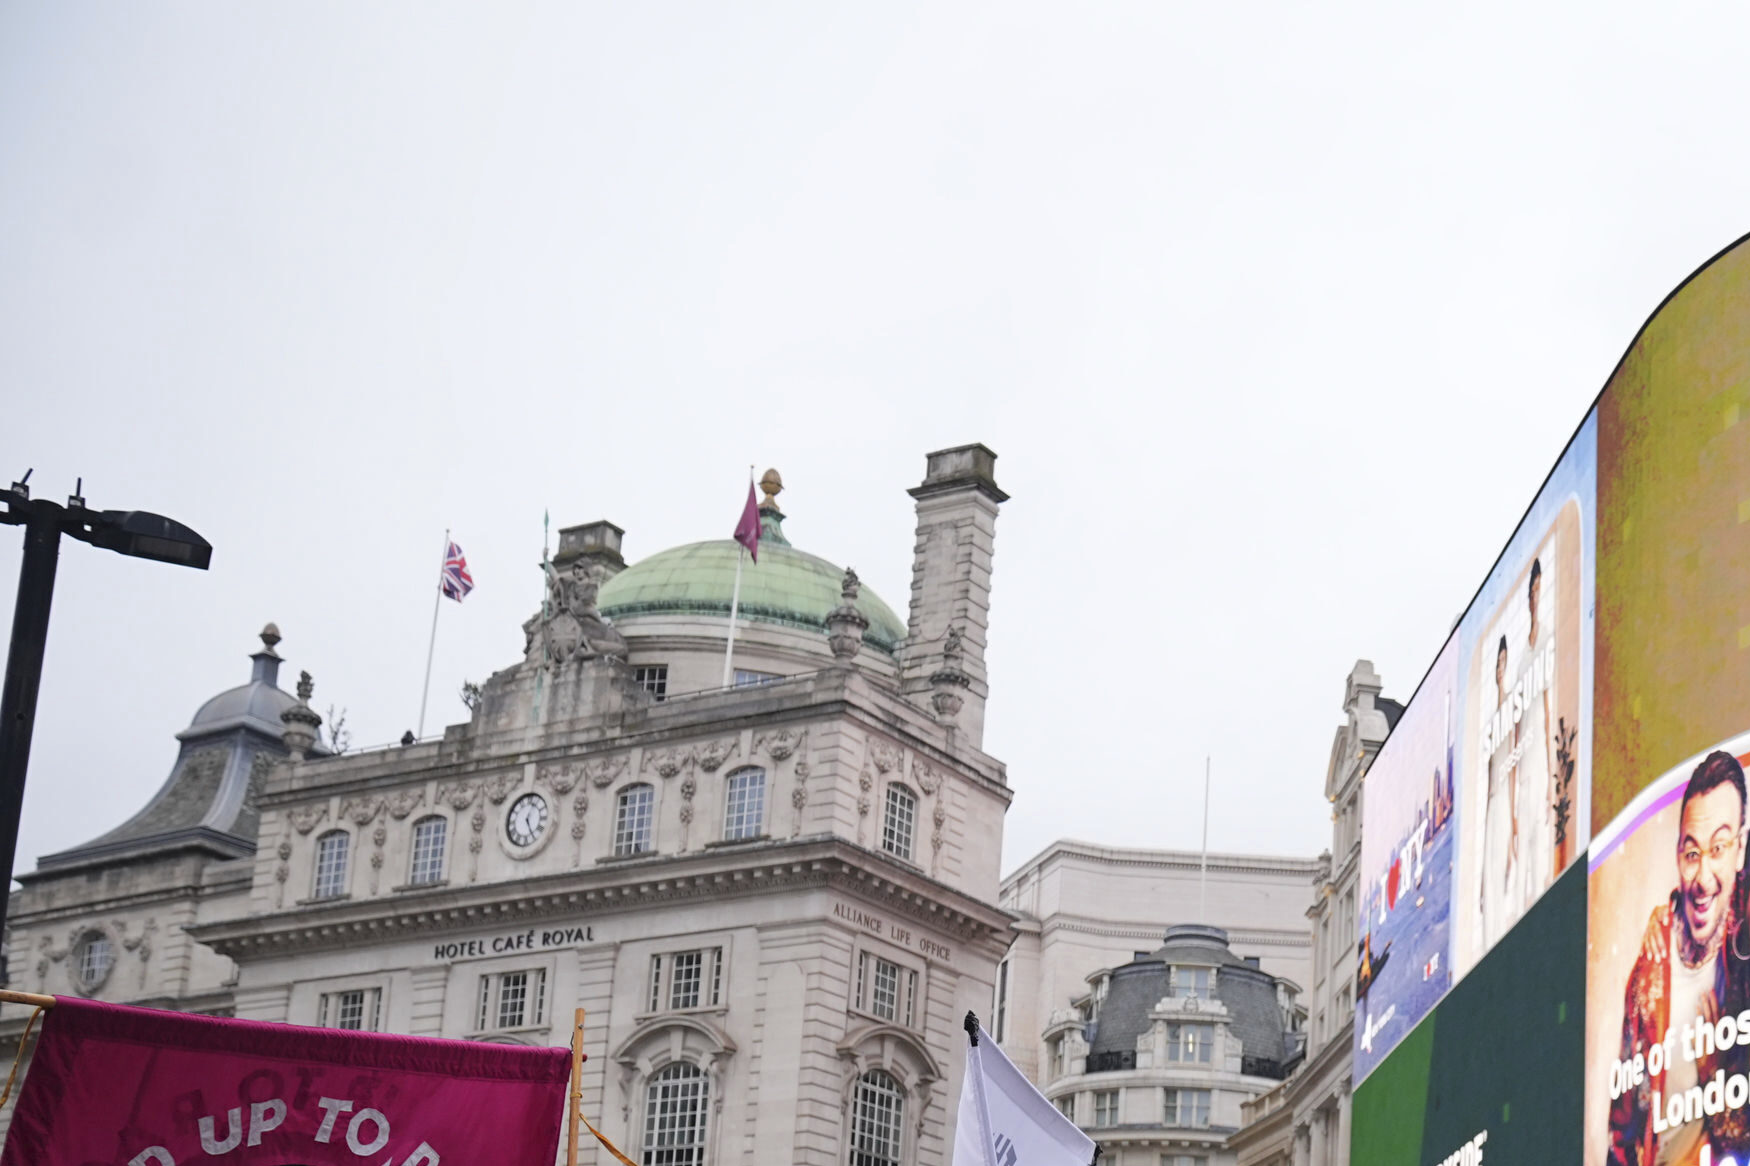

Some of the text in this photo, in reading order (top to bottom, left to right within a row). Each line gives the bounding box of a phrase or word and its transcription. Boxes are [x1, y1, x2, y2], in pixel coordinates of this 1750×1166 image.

[1483, 634, 1555, 755] SAMSUNG
[434, 926, 594, 959] HOTEL CAFÉ ROYAL
[833, 902, 951, 961] ALLIANCE LIFE OFFICE
[1608, 1052, 1645, 1100] One
[1647, 1027, 1676, 1077] of
[197, 1098, 288, 1157] UP
[312, 1095, 391, 1157] TO
